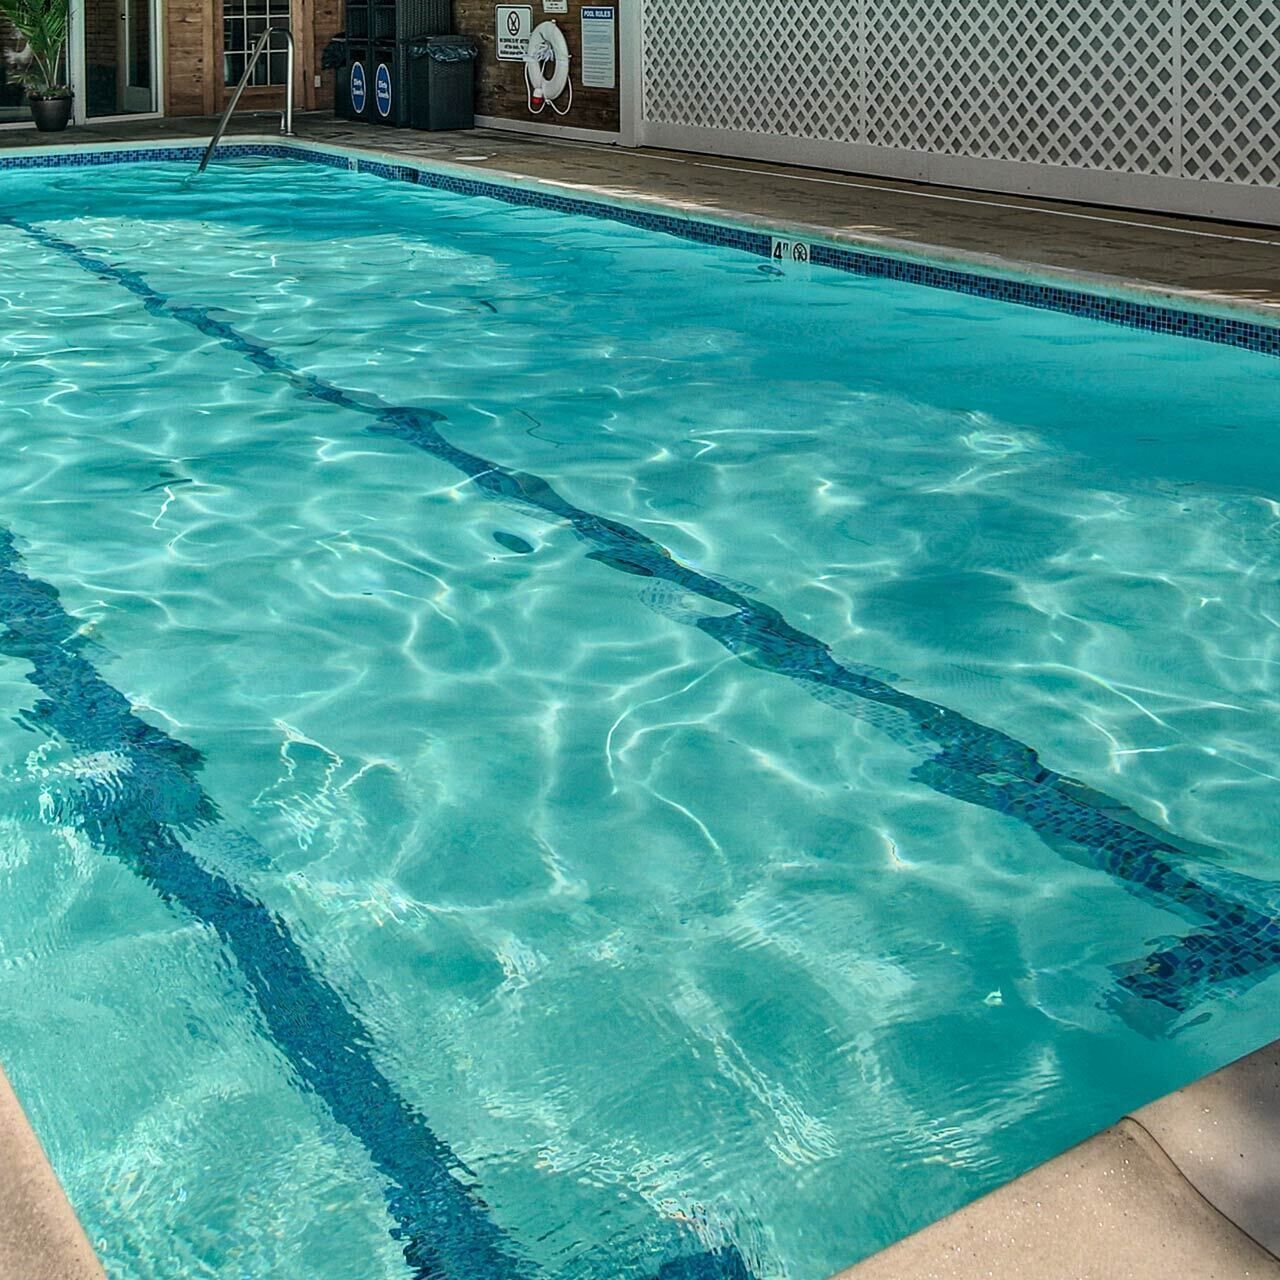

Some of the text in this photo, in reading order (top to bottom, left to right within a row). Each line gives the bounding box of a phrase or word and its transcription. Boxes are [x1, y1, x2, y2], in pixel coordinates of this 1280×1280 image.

[583, 10, 611, 19] POOL RULES
[773, 240, 783, 260] 4
